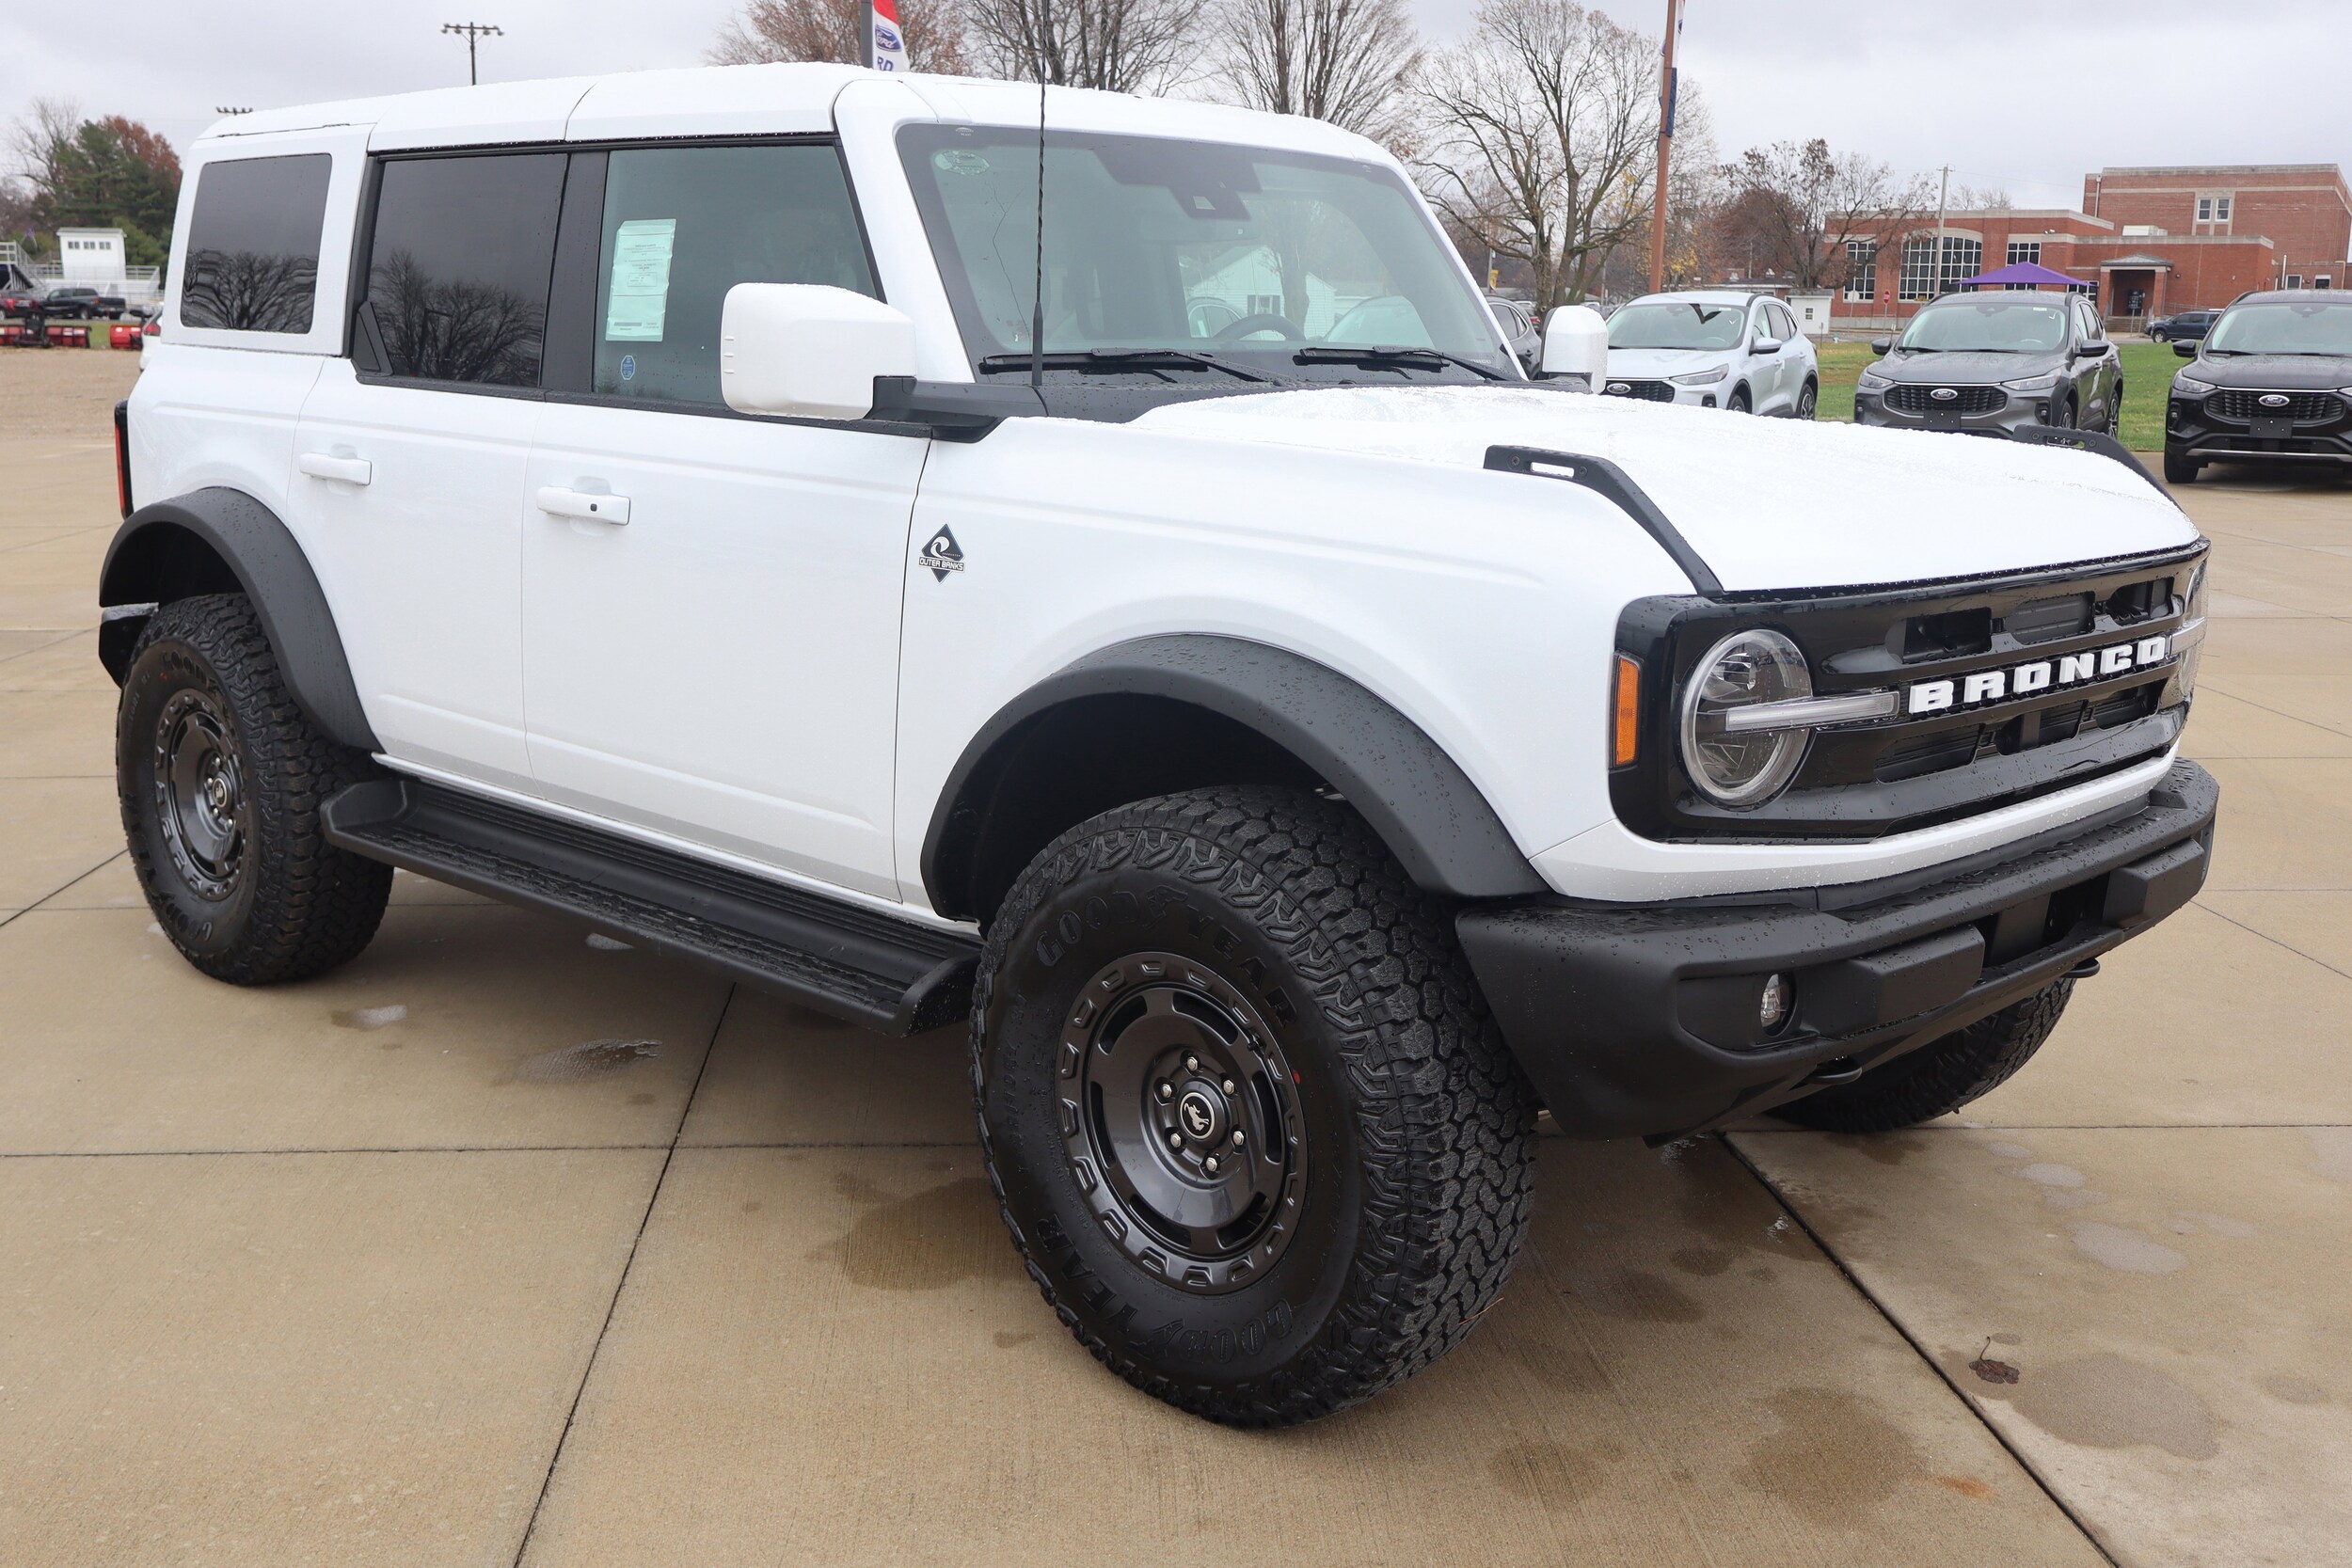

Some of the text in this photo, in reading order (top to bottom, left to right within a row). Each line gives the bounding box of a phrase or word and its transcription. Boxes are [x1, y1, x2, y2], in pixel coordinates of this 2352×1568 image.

[877, 30, 898, 49] Ford
[919, 558, 963, 571] OUTER BANKS
[1908, 636, 2166, 715] BRONCO
